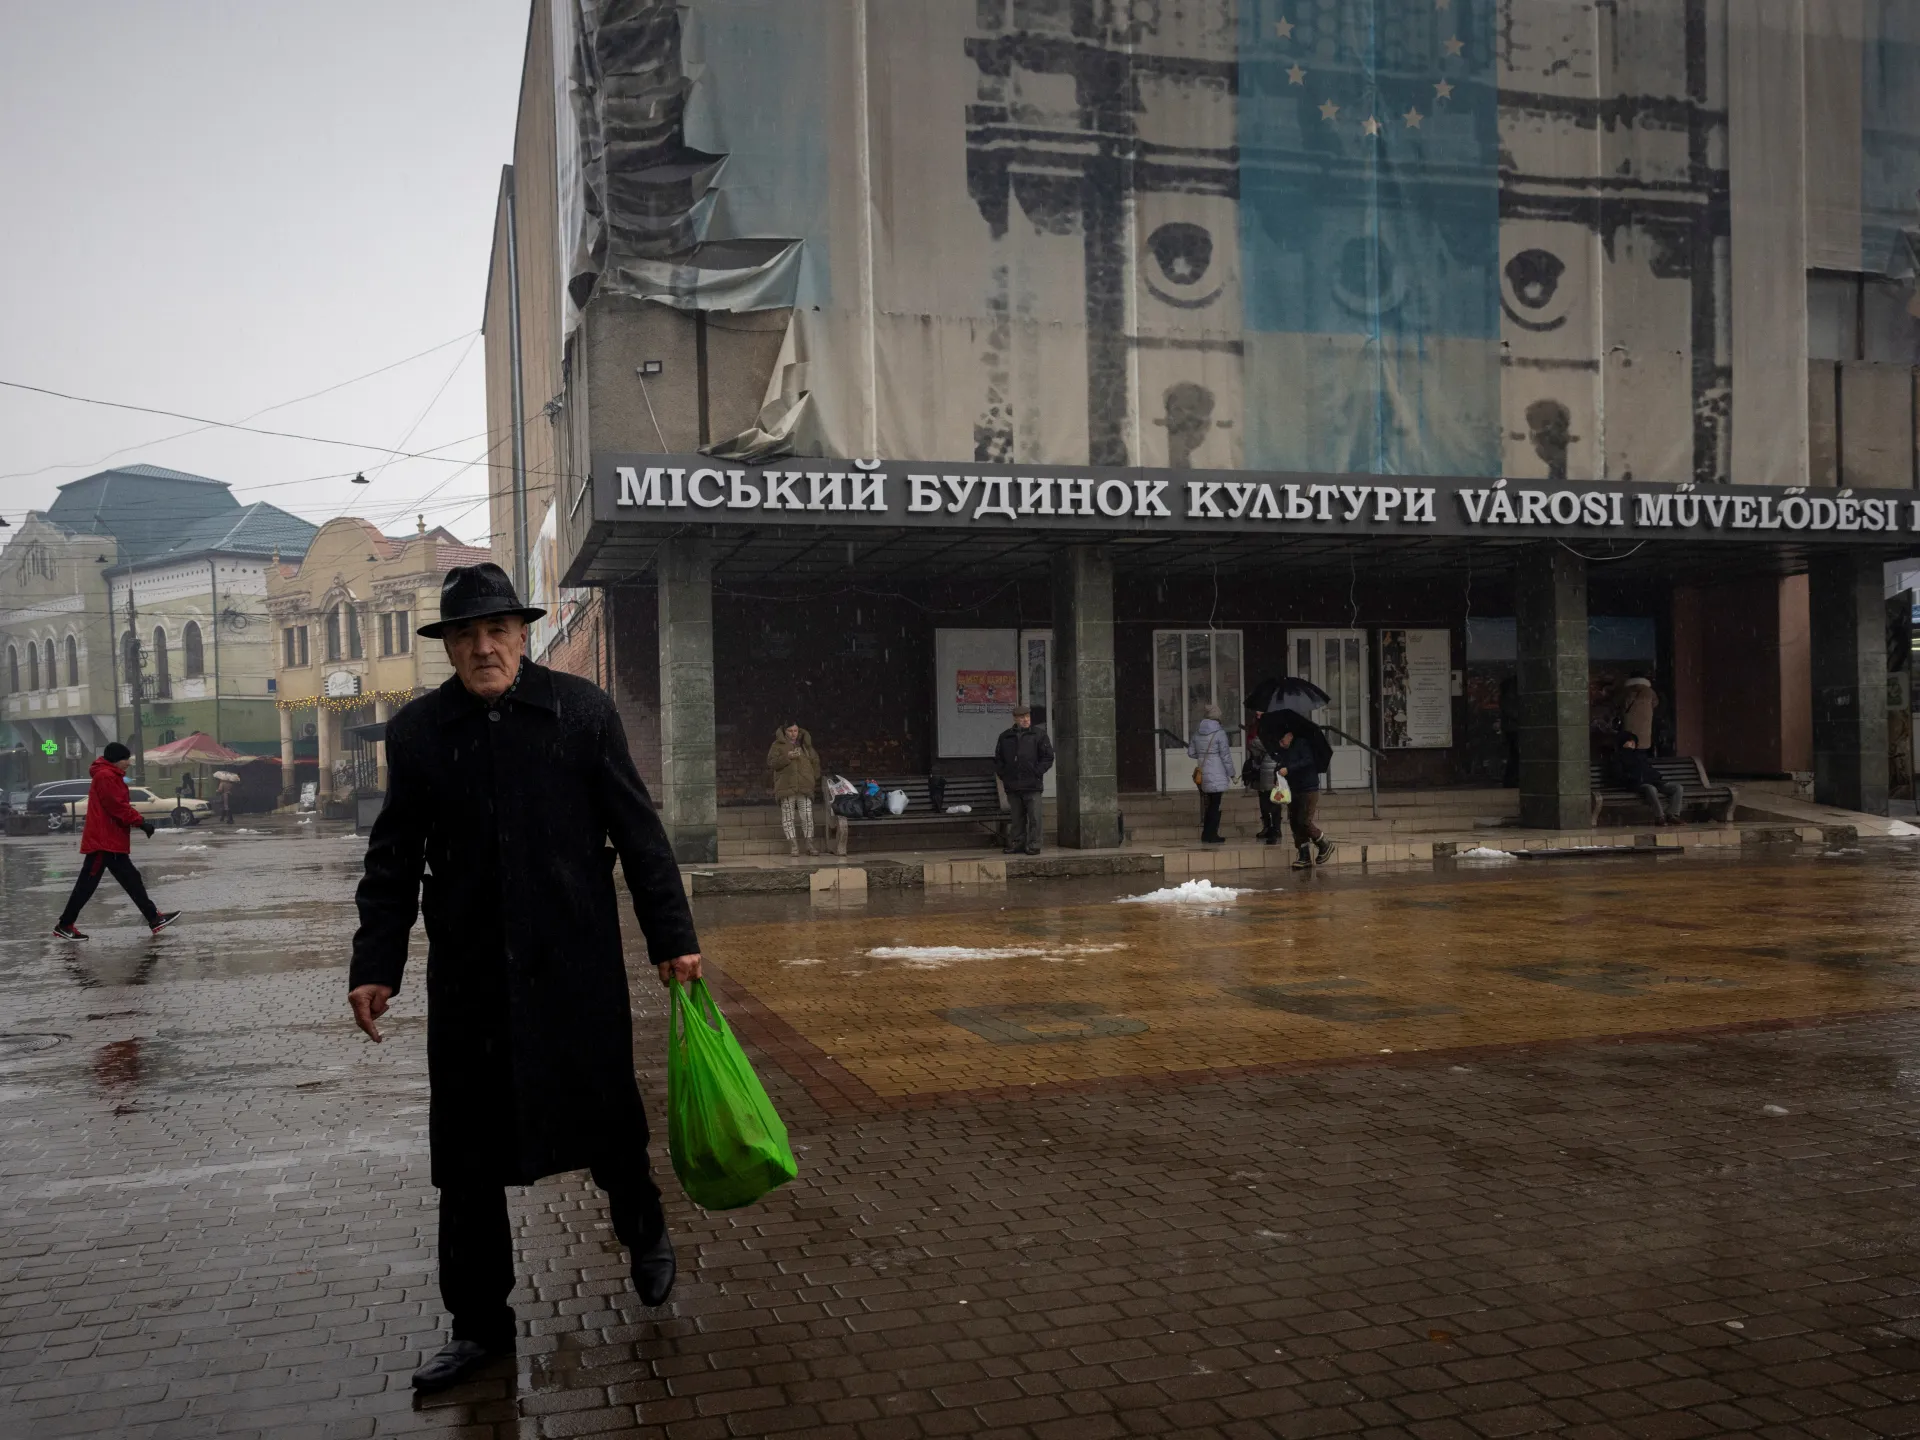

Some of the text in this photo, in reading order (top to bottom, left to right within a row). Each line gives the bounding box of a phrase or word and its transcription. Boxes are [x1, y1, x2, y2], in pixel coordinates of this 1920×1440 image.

[616, 458, 1436, 522] МІСЬКИЙ БУДИНОК КУЛЬТУРИ
[1459, 478, 1624, 525] VÁROSI
[1638, 483, 1898, 531] MŰVELŐDÉSI
